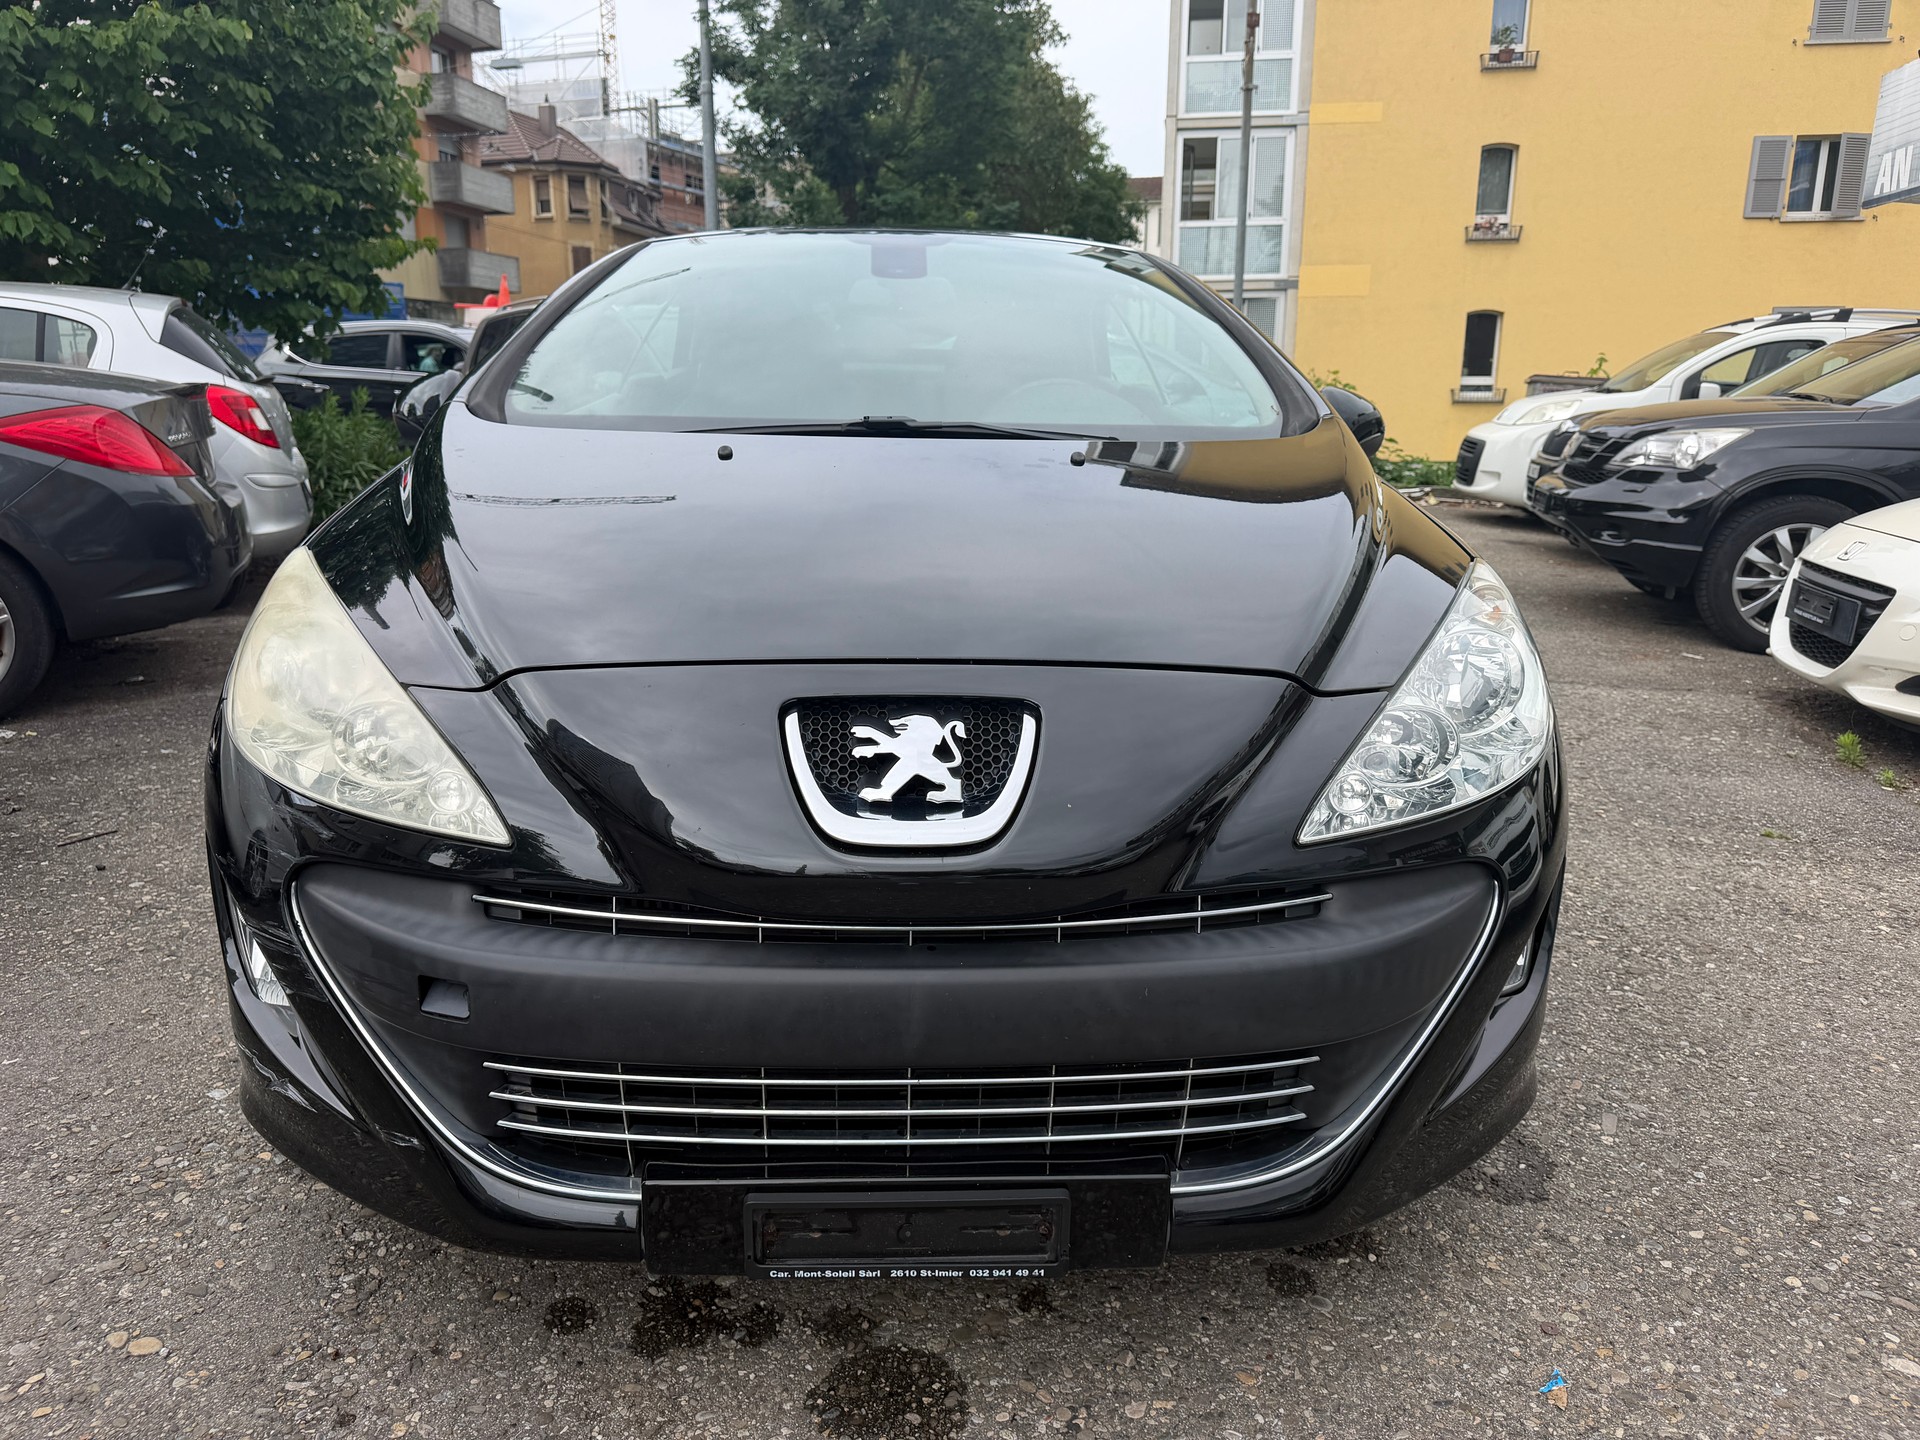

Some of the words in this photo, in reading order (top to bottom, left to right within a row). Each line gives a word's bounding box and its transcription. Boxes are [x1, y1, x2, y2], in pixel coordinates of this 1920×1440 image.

[769, 1270, 791, 1278] Car.
[794, 1270, 856, 1278] Mont-Soleil
[858, 1269, 881, 1278] Sàrl
[890, 1269, 917, 1278] 2610
[920, 1269, 963, 1277] St-Imier
[969, 1269, 990, 1277] 032
[992, 1269, 1012, 1277] 941
[1015, 1269, 1029, 1277] 49
[1032, 1269, 1045, 1277] 41
